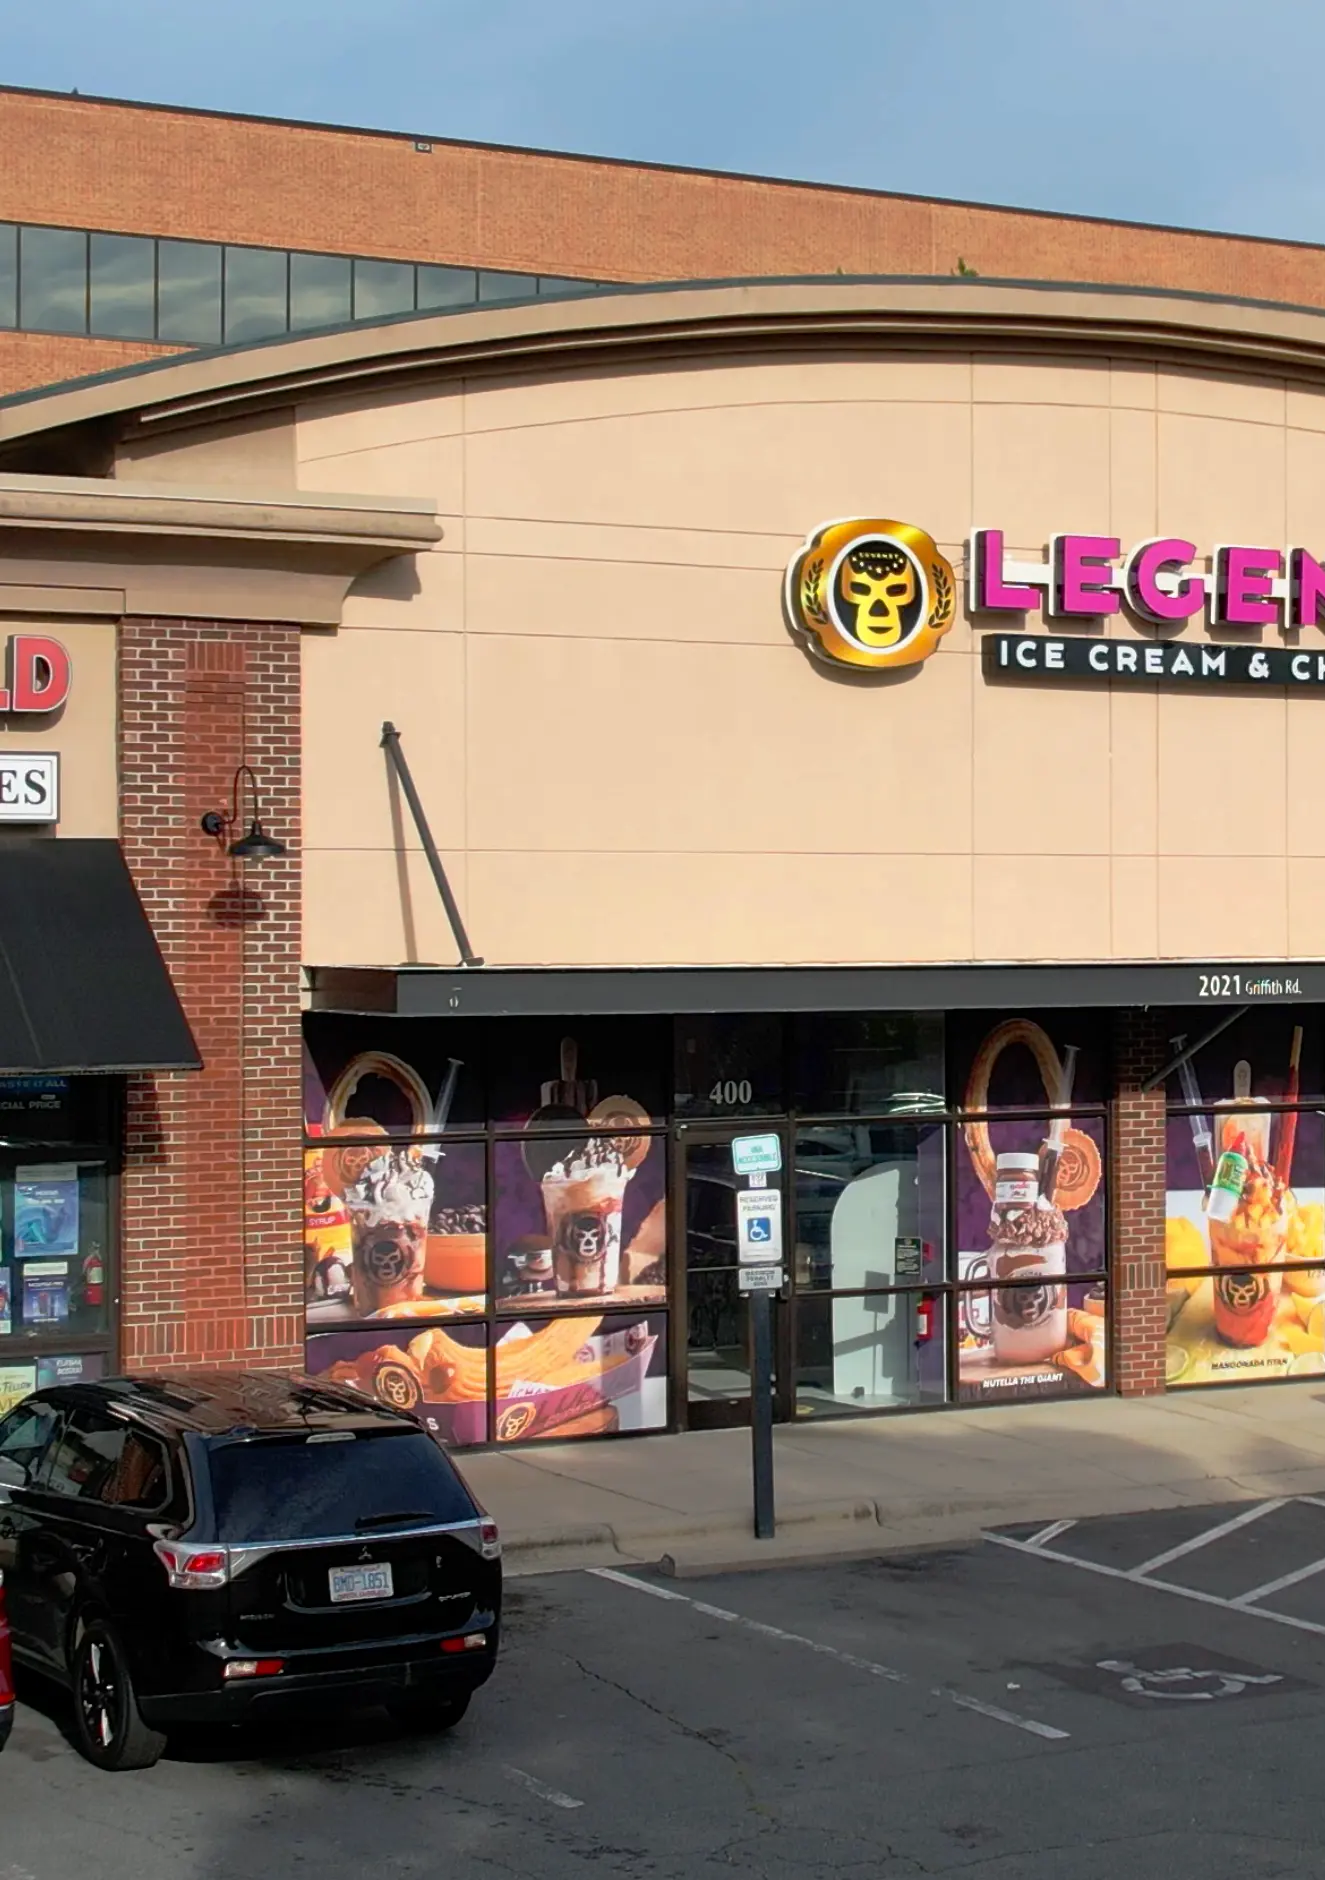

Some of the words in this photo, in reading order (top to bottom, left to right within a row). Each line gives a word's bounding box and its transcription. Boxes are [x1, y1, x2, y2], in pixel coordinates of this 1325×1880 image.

[1001, 640, 1065, 668] ICE
[1088, 645, 1226, 677] CREAM
[1248, 652, 1271, 679] &
[0, 768, 47, 806] ES
[1198, 974, 1241, 997] 2021
[1245, 978, 1283, 996] Griffith
[1285, 977, 1303, 995] Rd.
[708, 1079, 753, 1105] 400
[28, 1100, 62, 1110] PRICE
[982, 1377, 1019, 1389] NUTELLA
[1019, 1375, 1036, 1385] THE
[1036, 1372, 1065, 1384] GIANT
